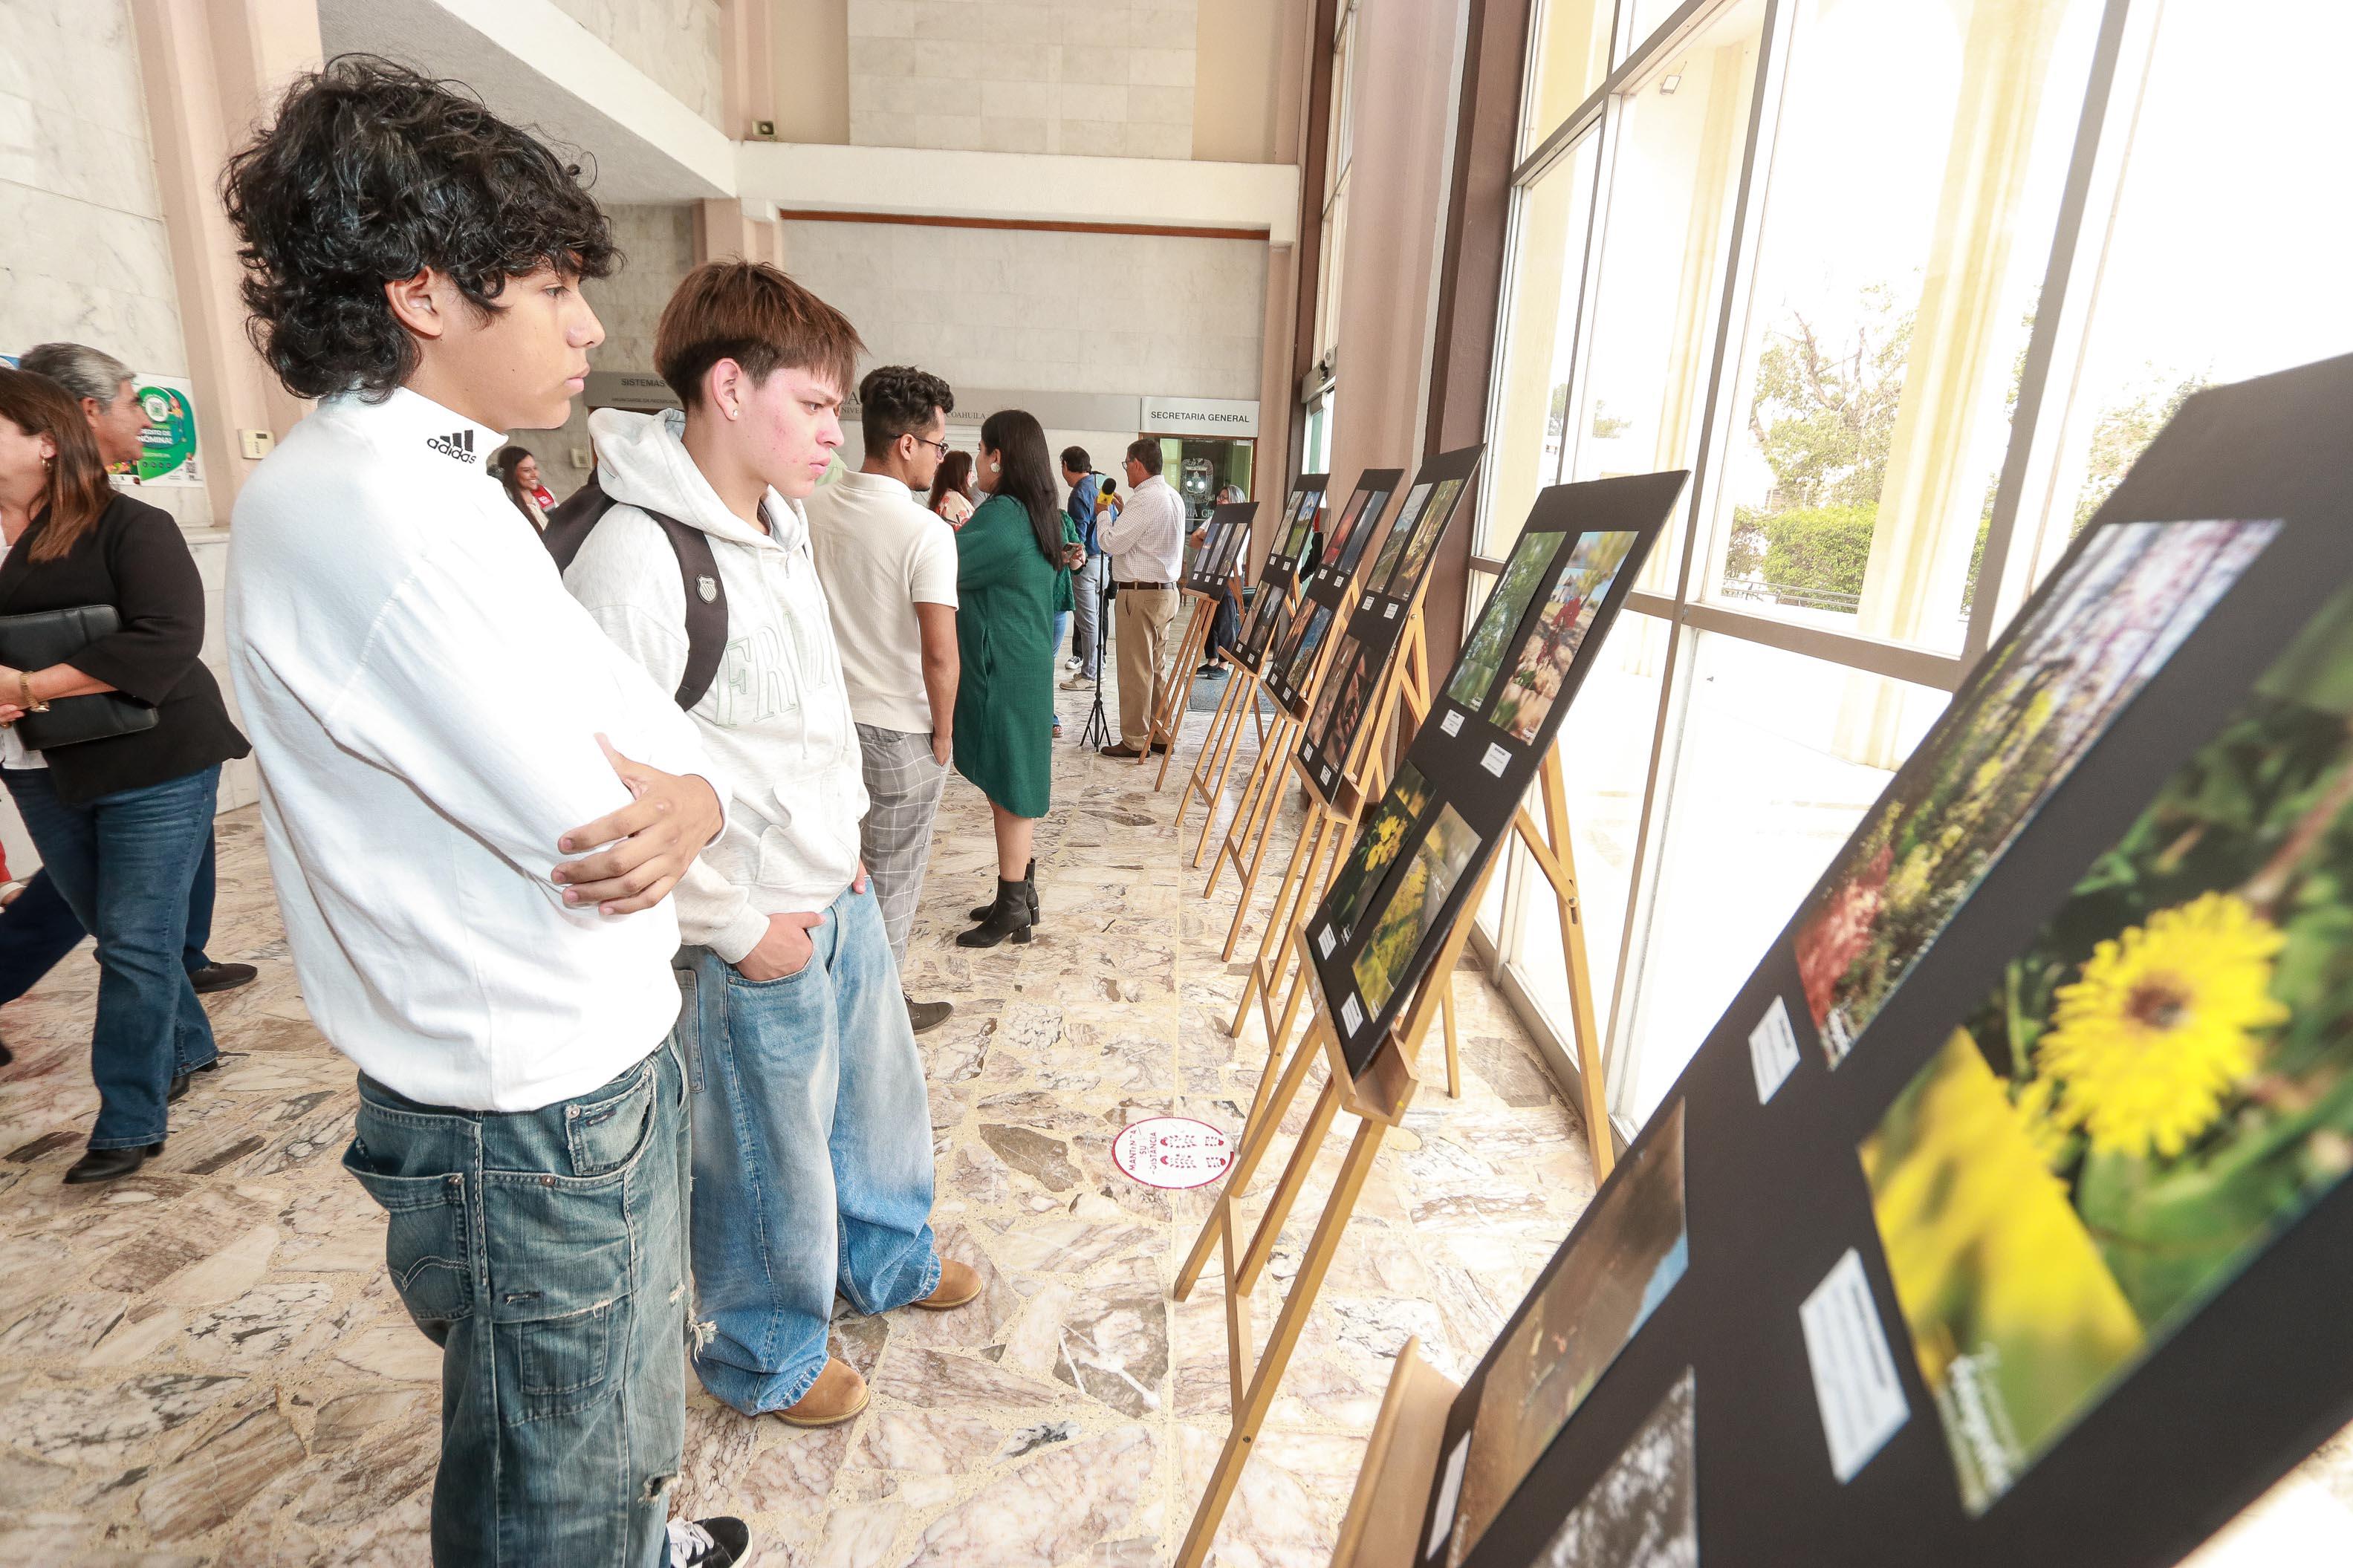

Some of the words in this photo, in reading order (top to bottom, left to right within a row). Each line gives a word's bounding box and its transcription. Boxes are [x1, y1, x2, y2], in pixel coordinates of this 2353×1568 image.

[621, 378, 666, 387] SISTEMAS
[946, 411, 986, 420] COAHUILA
[1151, 411, 1206, 420] SECRETARIA
[1208, 413, 1250, 423] GENERAL
[427, 437, 477, 464] adidas
